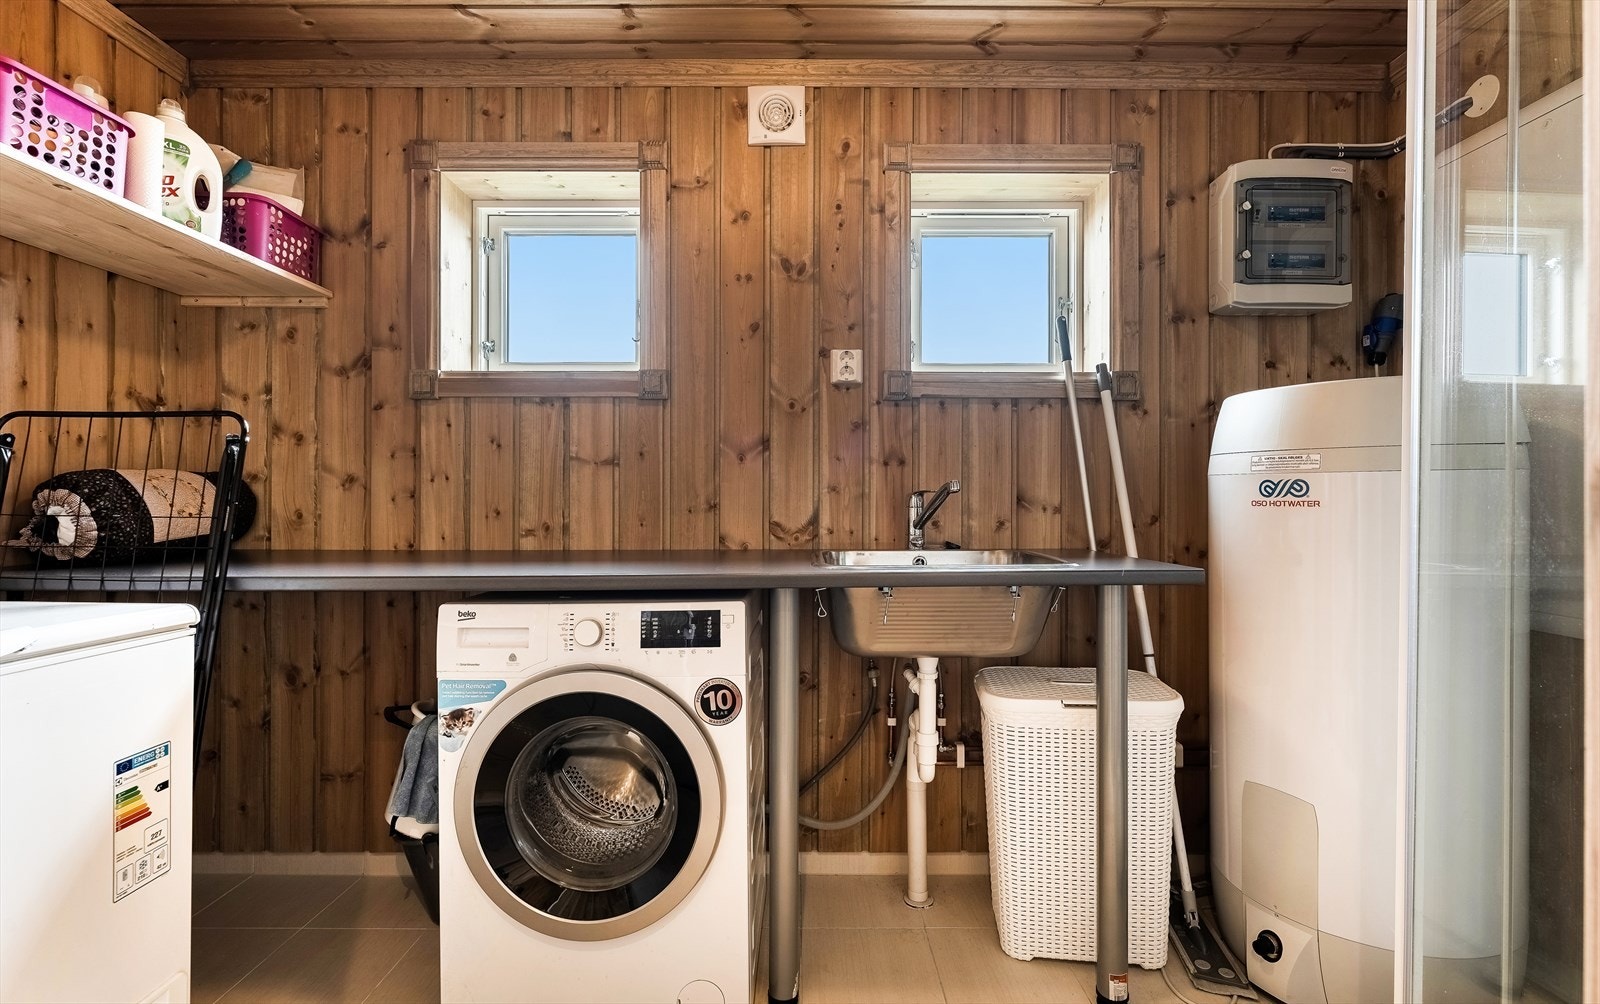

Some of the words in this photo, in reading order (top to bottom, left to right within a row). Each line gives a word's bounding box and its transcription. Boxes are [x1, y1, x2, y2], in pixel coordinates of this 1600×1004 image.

[457, 610, 477, 618] beko
[703, 689, 733, 711] 10
[134, 751, 155, 764] ENERG
[150, 829, 162, 841] 227
